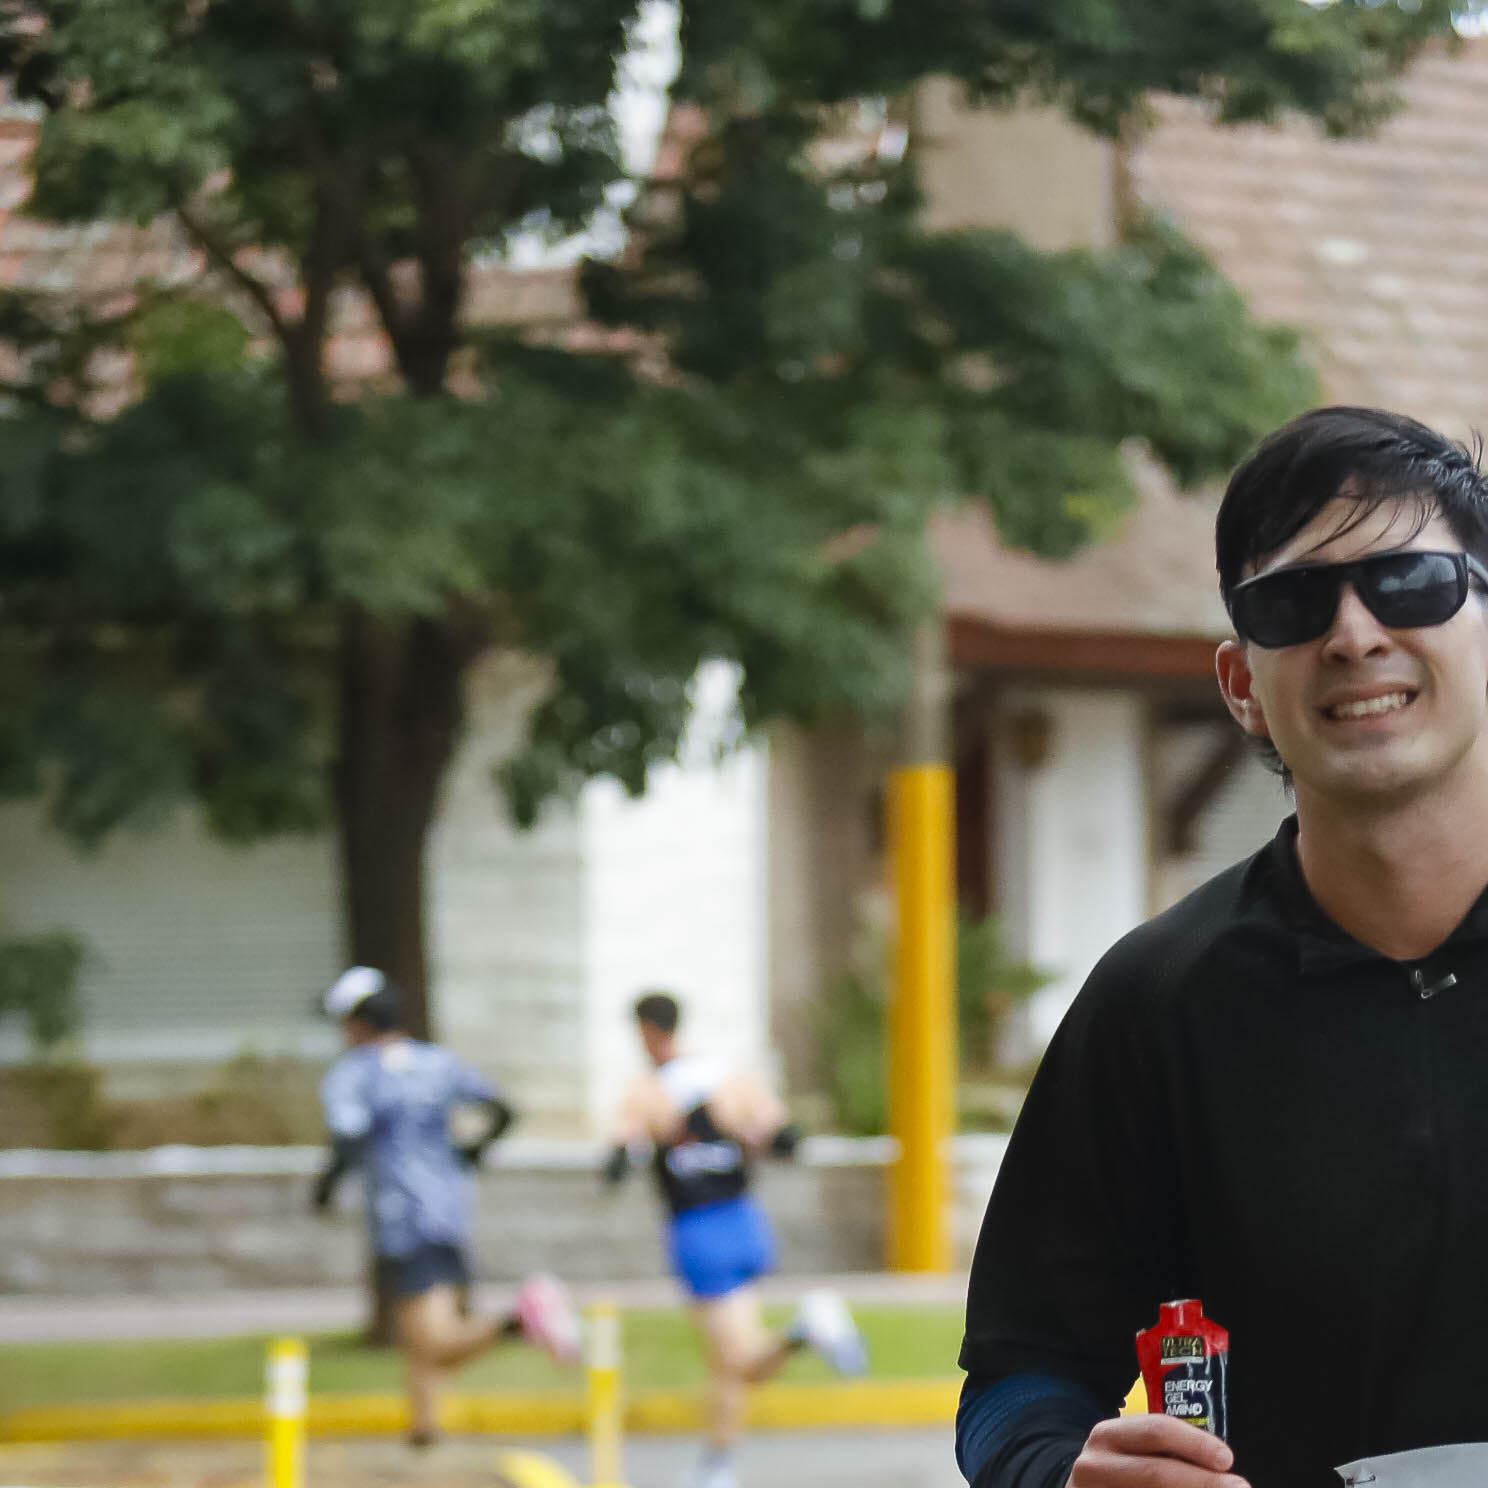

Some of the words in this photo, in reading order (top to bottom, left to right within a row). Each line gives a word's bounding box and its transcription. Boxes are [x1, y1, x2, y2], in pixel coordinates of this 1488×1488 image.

[1163, 1345, 1203, 1357] TECH
[1164, 1380, 1213, 1393] ENERGY
[1165, 1392, 1189, 1404] GEL
[1166, 1403, 1203, 1417] AMINO
